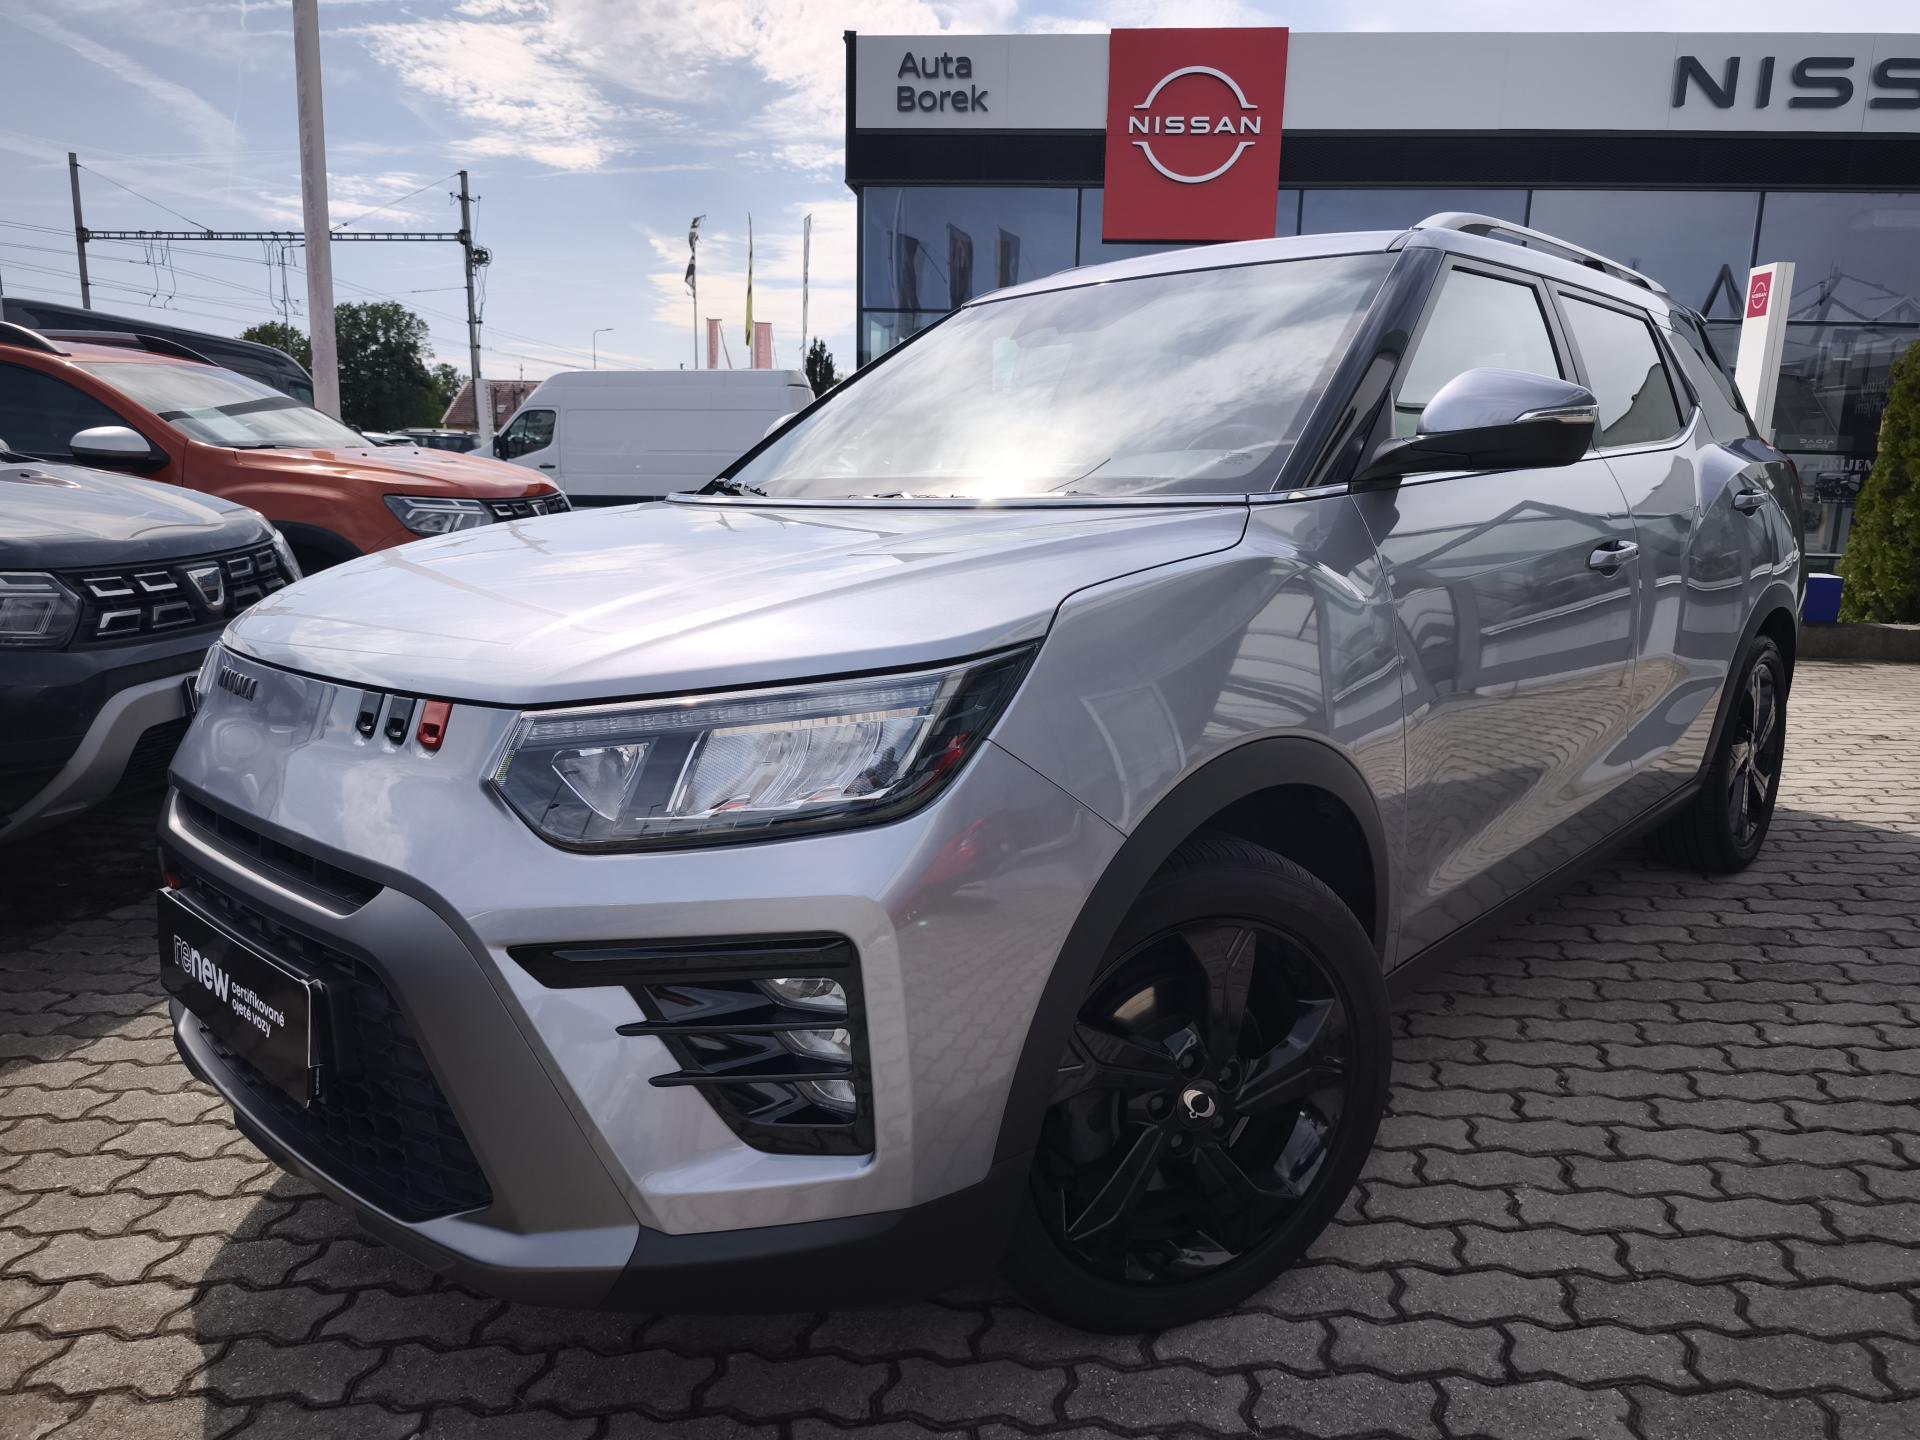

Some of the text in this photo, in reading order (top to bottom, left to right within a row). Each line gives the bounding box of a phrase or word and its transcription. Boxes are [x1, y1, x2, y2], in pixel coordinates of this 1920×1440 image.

[897, 51, 972, 79] Auta
[1672, 55, 1920, 109] NISS
[897, 84, 989, 112] Borek
[1128, 116, 1261, 135] NISSAN
[1751, 291, 1768, 299] NISSAN
[173, 934, 230, 1003] renew
[231, 981, 285, 1027] certifikované
[231, 998, 272, 1038] ojeté vozy
